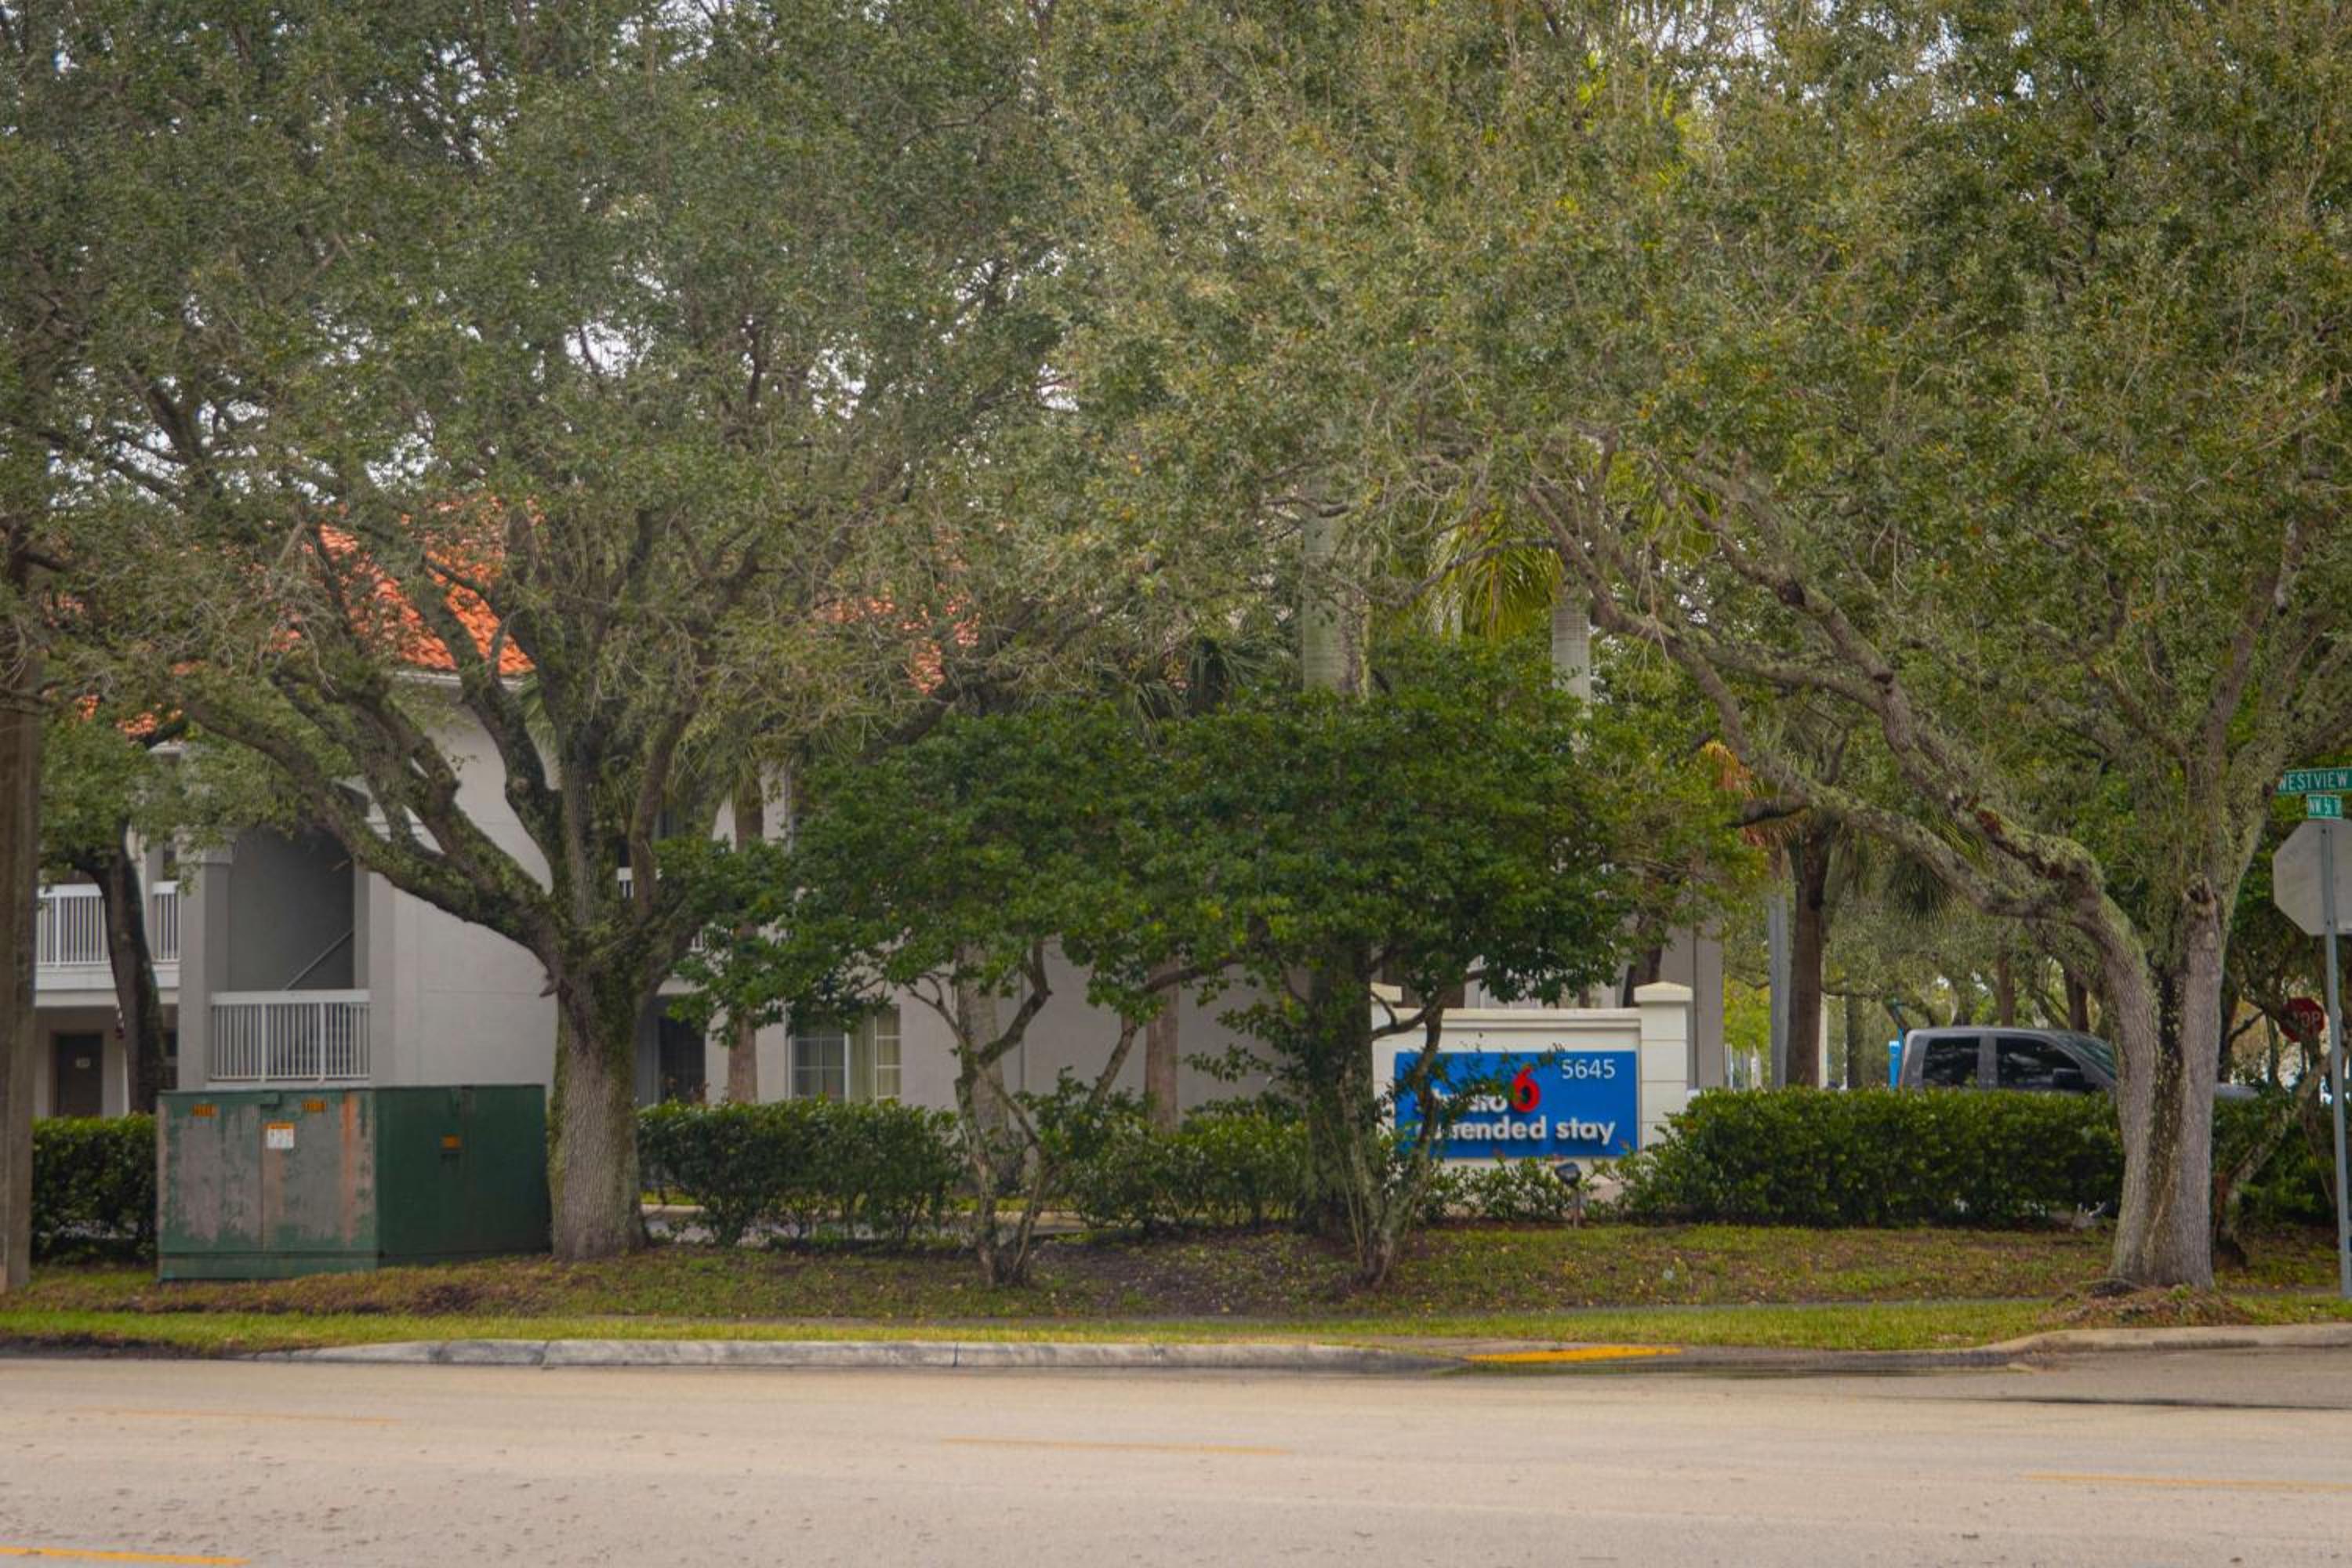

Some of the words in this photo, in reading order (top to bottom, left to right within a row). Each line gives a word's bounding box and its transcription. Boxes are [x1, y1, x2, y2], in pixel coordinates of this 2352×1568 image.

[2278, 771, 2348, 791] WESTVIEW
[1561, 1059, 1616, 1080] 5645
[1510, 1063, 1541, 1112] 6
[1555, 1117, 1616, 1145] stay
